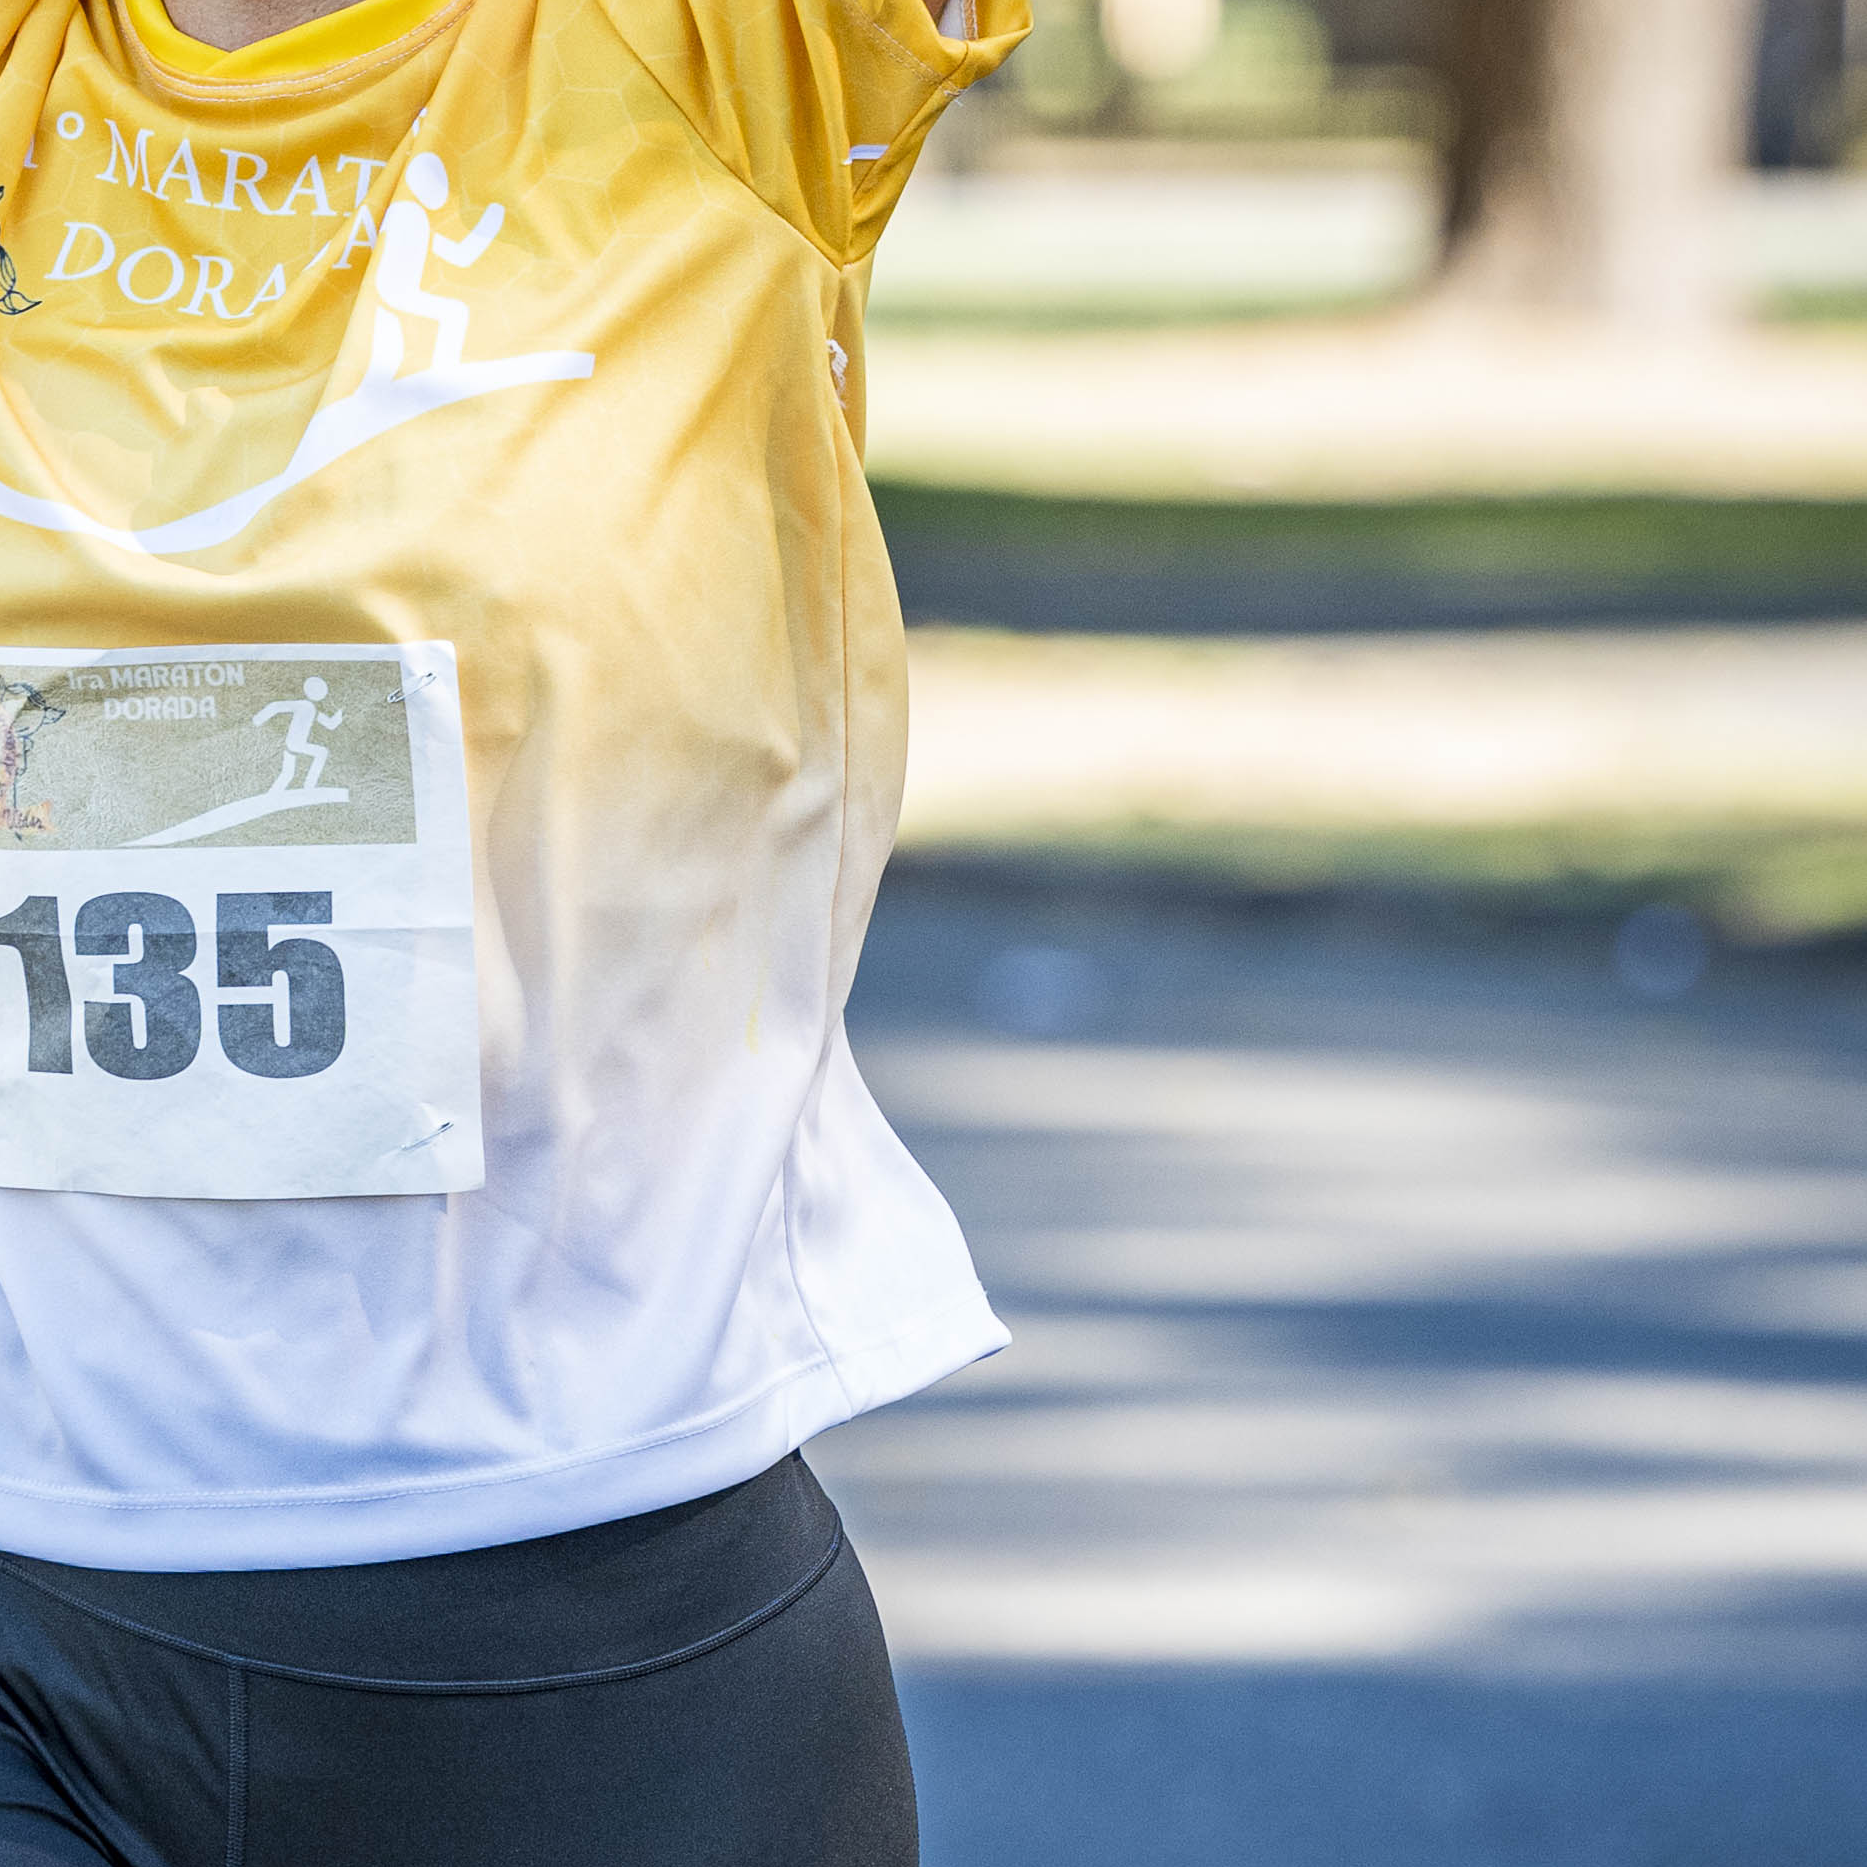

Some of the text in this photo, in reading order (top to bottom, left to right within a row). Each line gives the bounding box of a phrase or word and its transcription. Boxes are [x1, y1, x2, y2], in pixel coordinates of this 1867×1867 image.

[95, 107, 427, 218] MARAT
[45, 221, 379, 320] DORAA
[109, 662, 247, 689] MARATON
[103, 695, 217, 721] DORADA
